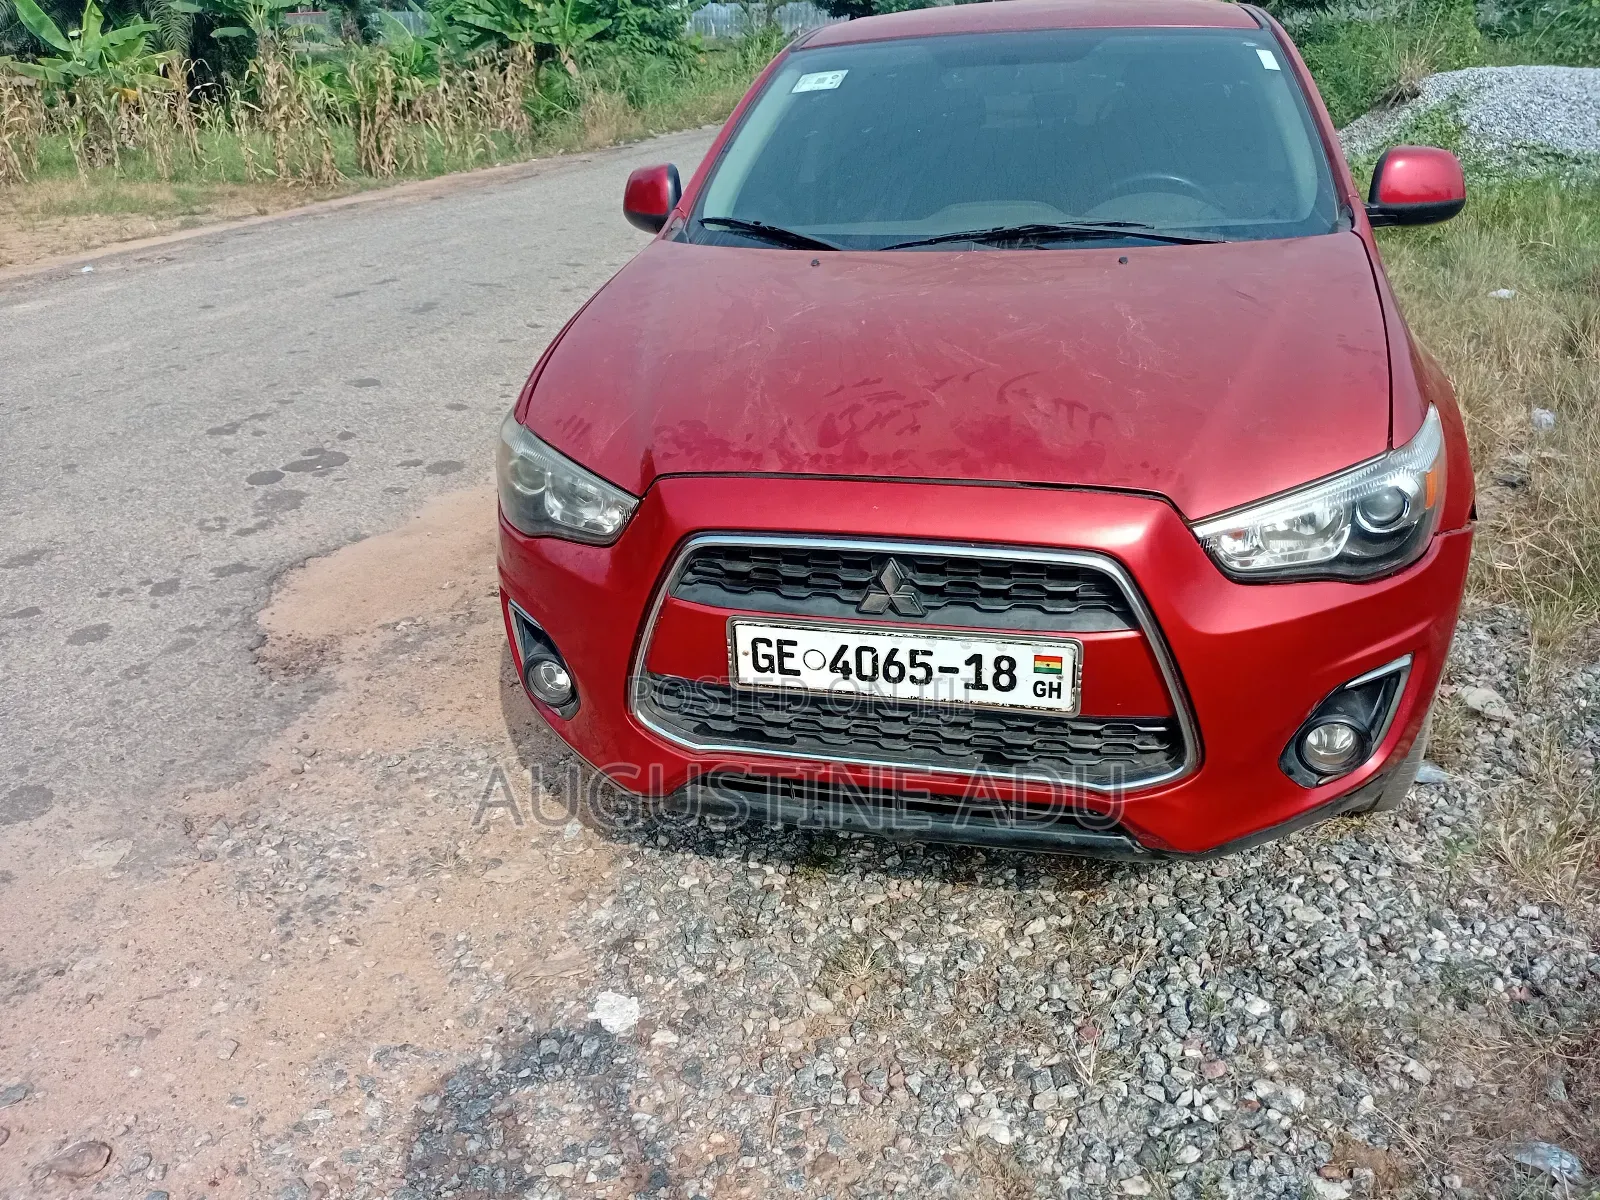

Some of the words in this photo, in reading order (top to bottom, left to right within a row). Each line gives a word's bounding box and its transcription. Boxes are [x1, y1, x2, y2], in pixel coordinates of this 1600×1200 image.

[751, 637, 801, 677] GE
[829, 644, 1018, 693] 4065-18
[1032, 680, 1062, 699] GH
